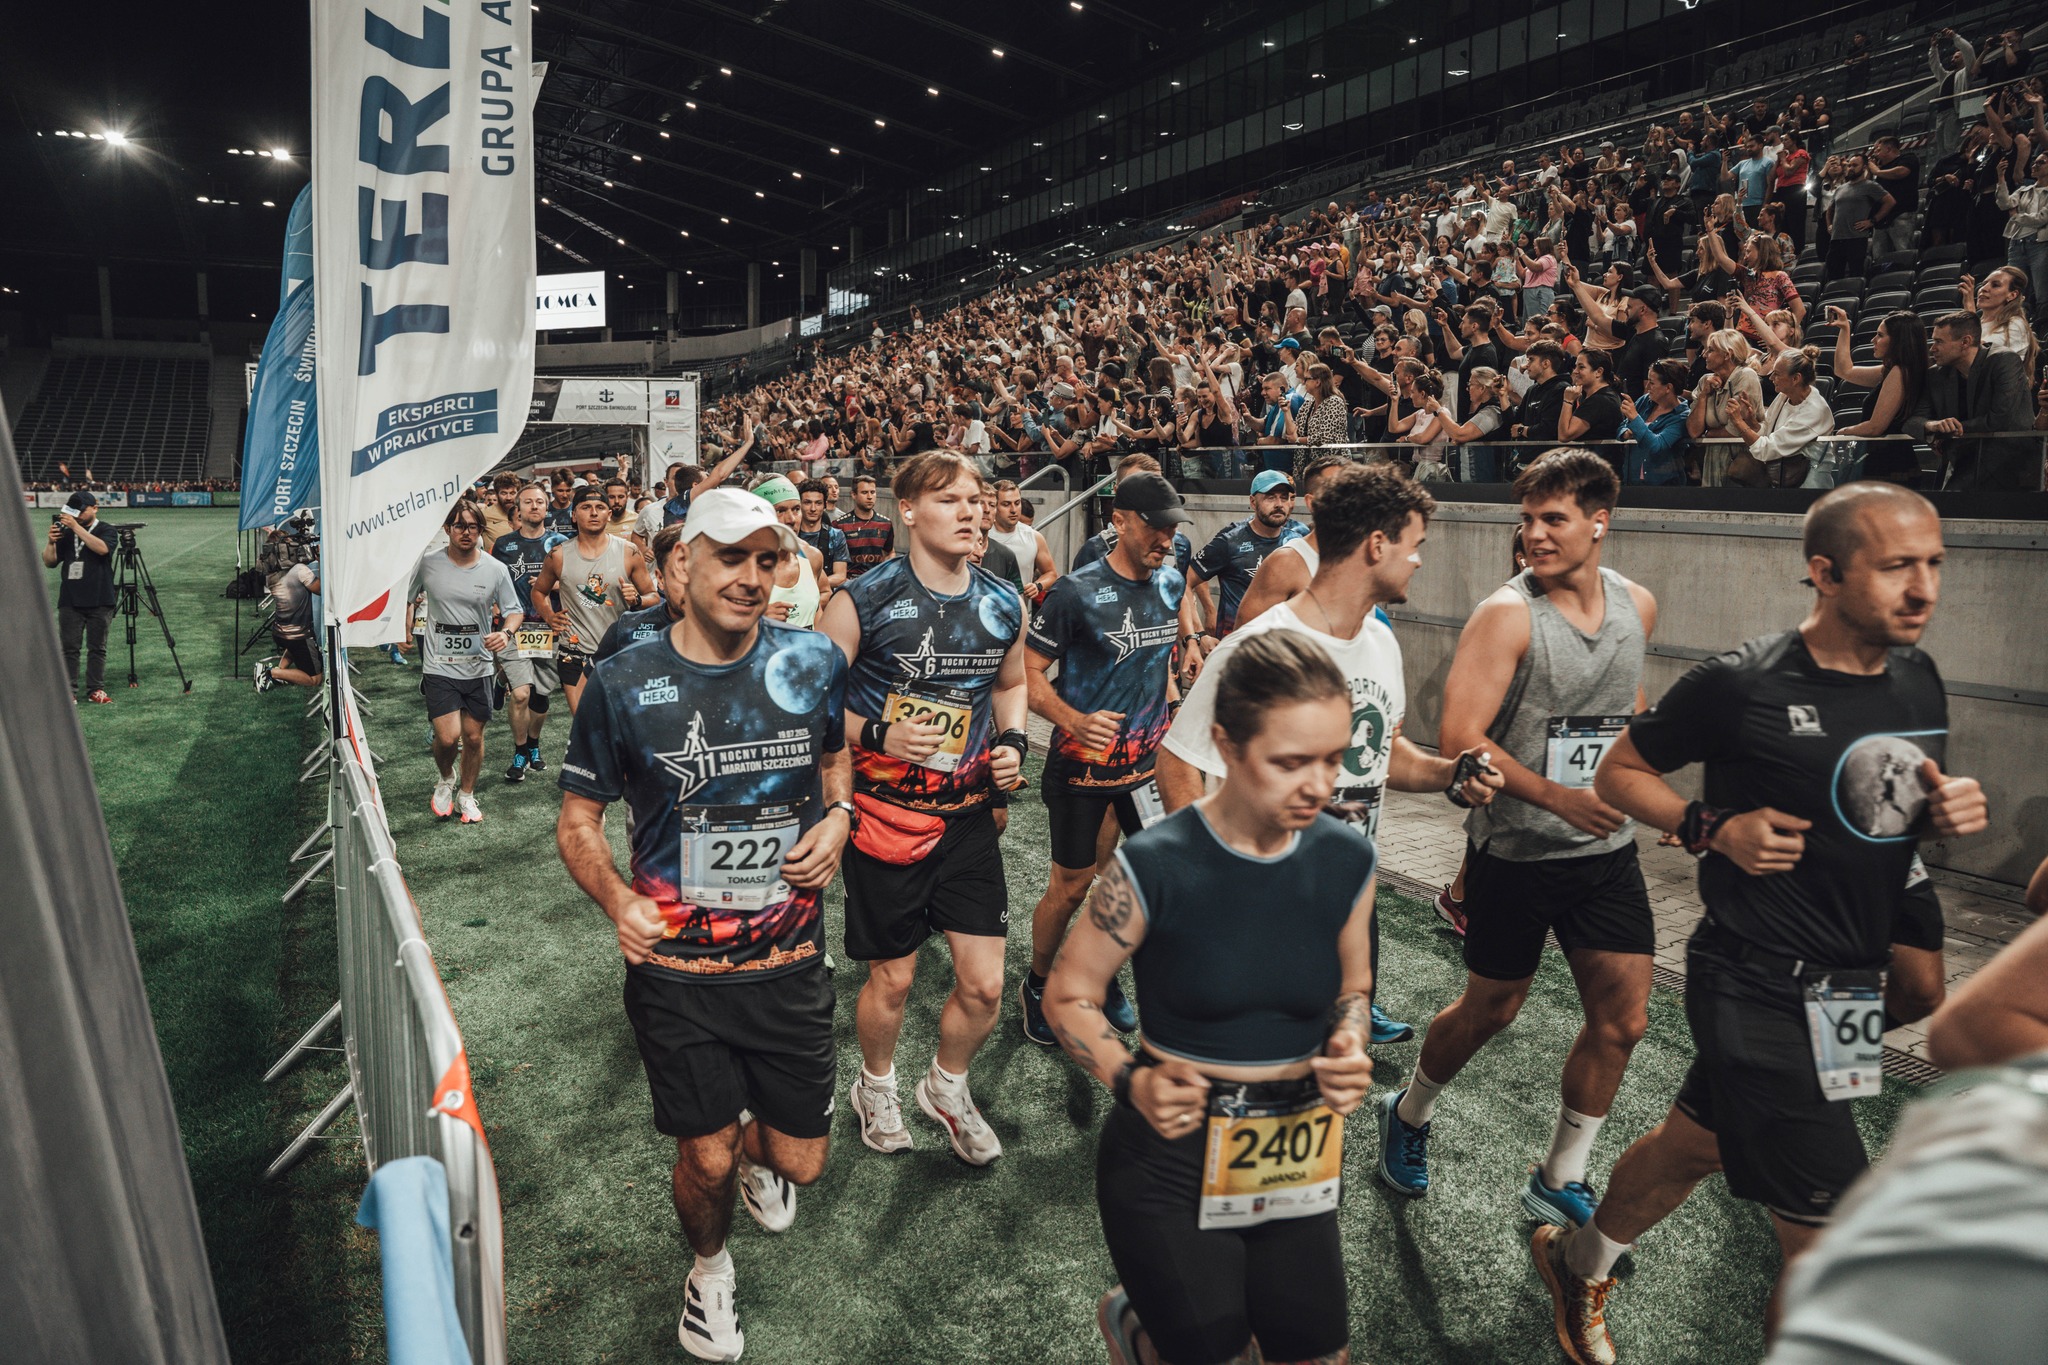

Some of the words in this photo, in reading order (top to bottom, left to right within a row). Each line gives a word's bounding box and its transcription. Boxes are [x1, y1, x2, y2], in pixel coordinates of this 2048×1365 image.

[481, 45, 515, 176] GRUPA
[359, 0, 450, 376] TERL
[293, 322, 315, 383] ŚWINO
[388, 396, 474, 427] EKSPERCI
[280, 399, 307, 471] SZCZECIN
[368, 445, 382, 464] W
[384, 418, 474, 456] PRAKTYCE
[274, 477, 292, 516] PORT
[892, 607, 917, 618] HERO
[894, 599, 913, 608] JUST
[638, 623, 655, 631] JUST
[445, 637, 472, 649] 350
[520, 633, 550, 644] 2097
[941, 658, 968, 667] NOCNY
[644, 675, 671, 690] JUST
[643, 689, 676, 703] HERO
[1347, 678, 1393, 715] PORTING
[720, 748, 757, 763] NOCNY
[762, 742, 811, 757] PORTOWY
[721, 760, 762, 775] MARATON
[763, 754, 812, 770] SZCZECIŃSKI
[710, 837, 781, 870] 222
[727, 876, 767, 884] TOMASZ
[1228, 1114, 1333, 1169] 2407
